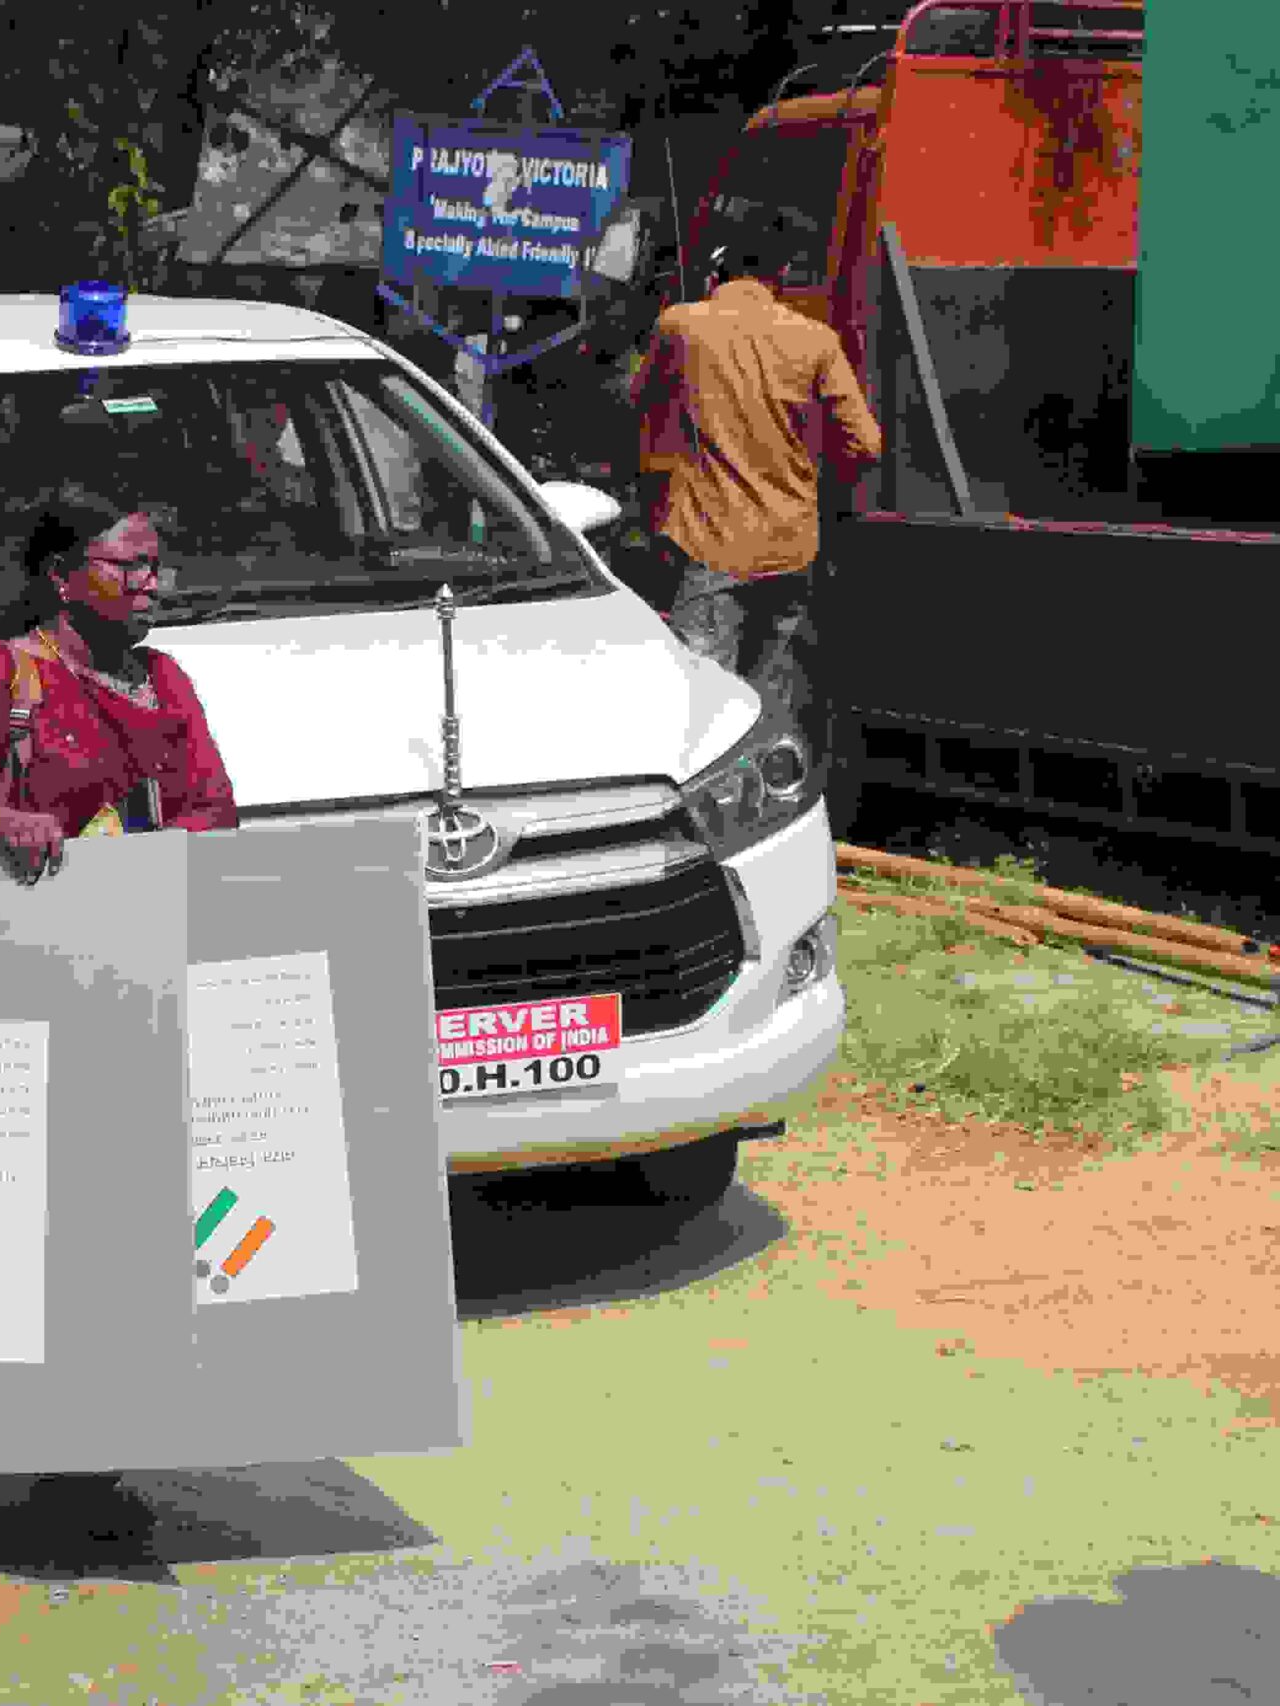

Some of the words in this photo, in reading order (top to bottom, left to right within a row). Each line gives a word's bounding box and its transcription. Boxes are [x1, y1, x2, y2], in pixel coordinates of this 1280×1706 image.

[521, 156, 608, 189] VICTORIA
[533, 1032, 556, 1051] OF
[561, 1026, 610, 1052] INDIA
